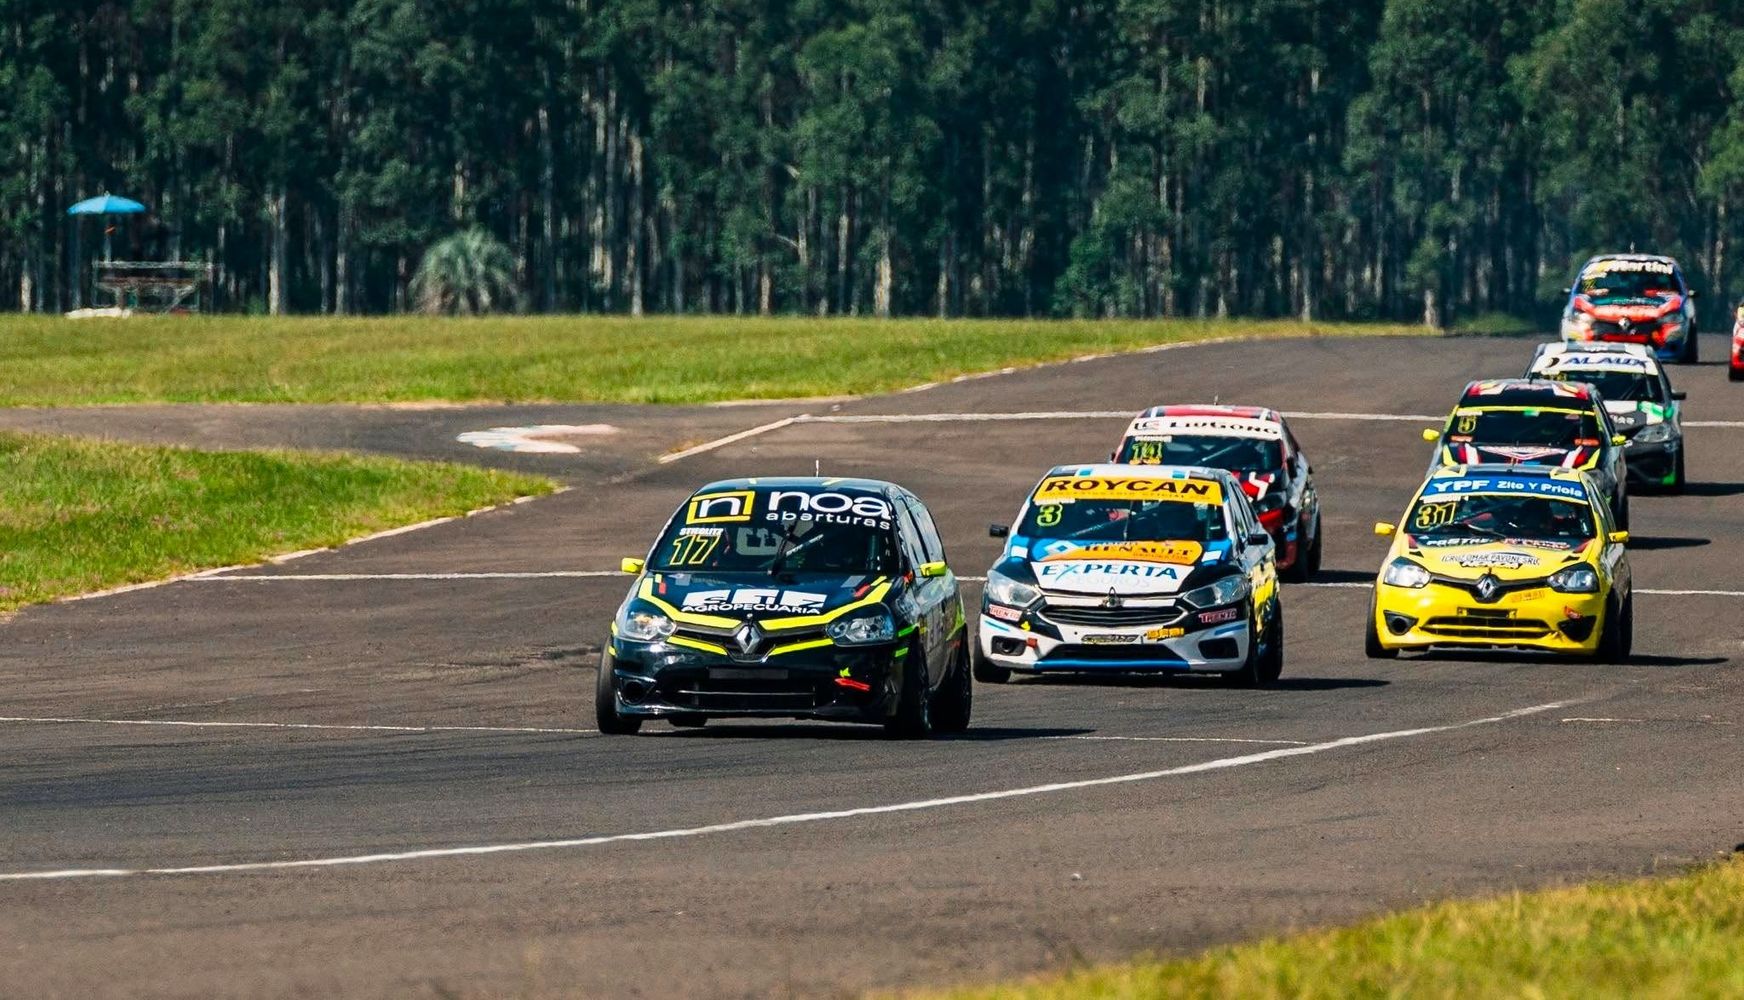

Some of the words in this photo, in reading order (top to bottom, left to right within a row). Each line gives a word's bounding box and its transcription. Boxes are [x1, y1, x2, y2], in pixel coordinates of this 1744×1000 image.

[1045, 479, 1211, 496] ROYCAN
[1432, 480, 1490, 492] YPF
[1497, 480, 1525, 490] Zito
[1528, 482, 1539, 490] Y
[1540, 483, 1583, 498] Priola
[768, 490, 894, 520] noa
[1036, 503, 1063, 527] 3
[1415, 502, 1457, 529] 31
[669, 534, 721, 566] 17
[1041, 563, 1179, 582] EXPERTA
[680, 603, 822, 615] AGROPECUARIA
